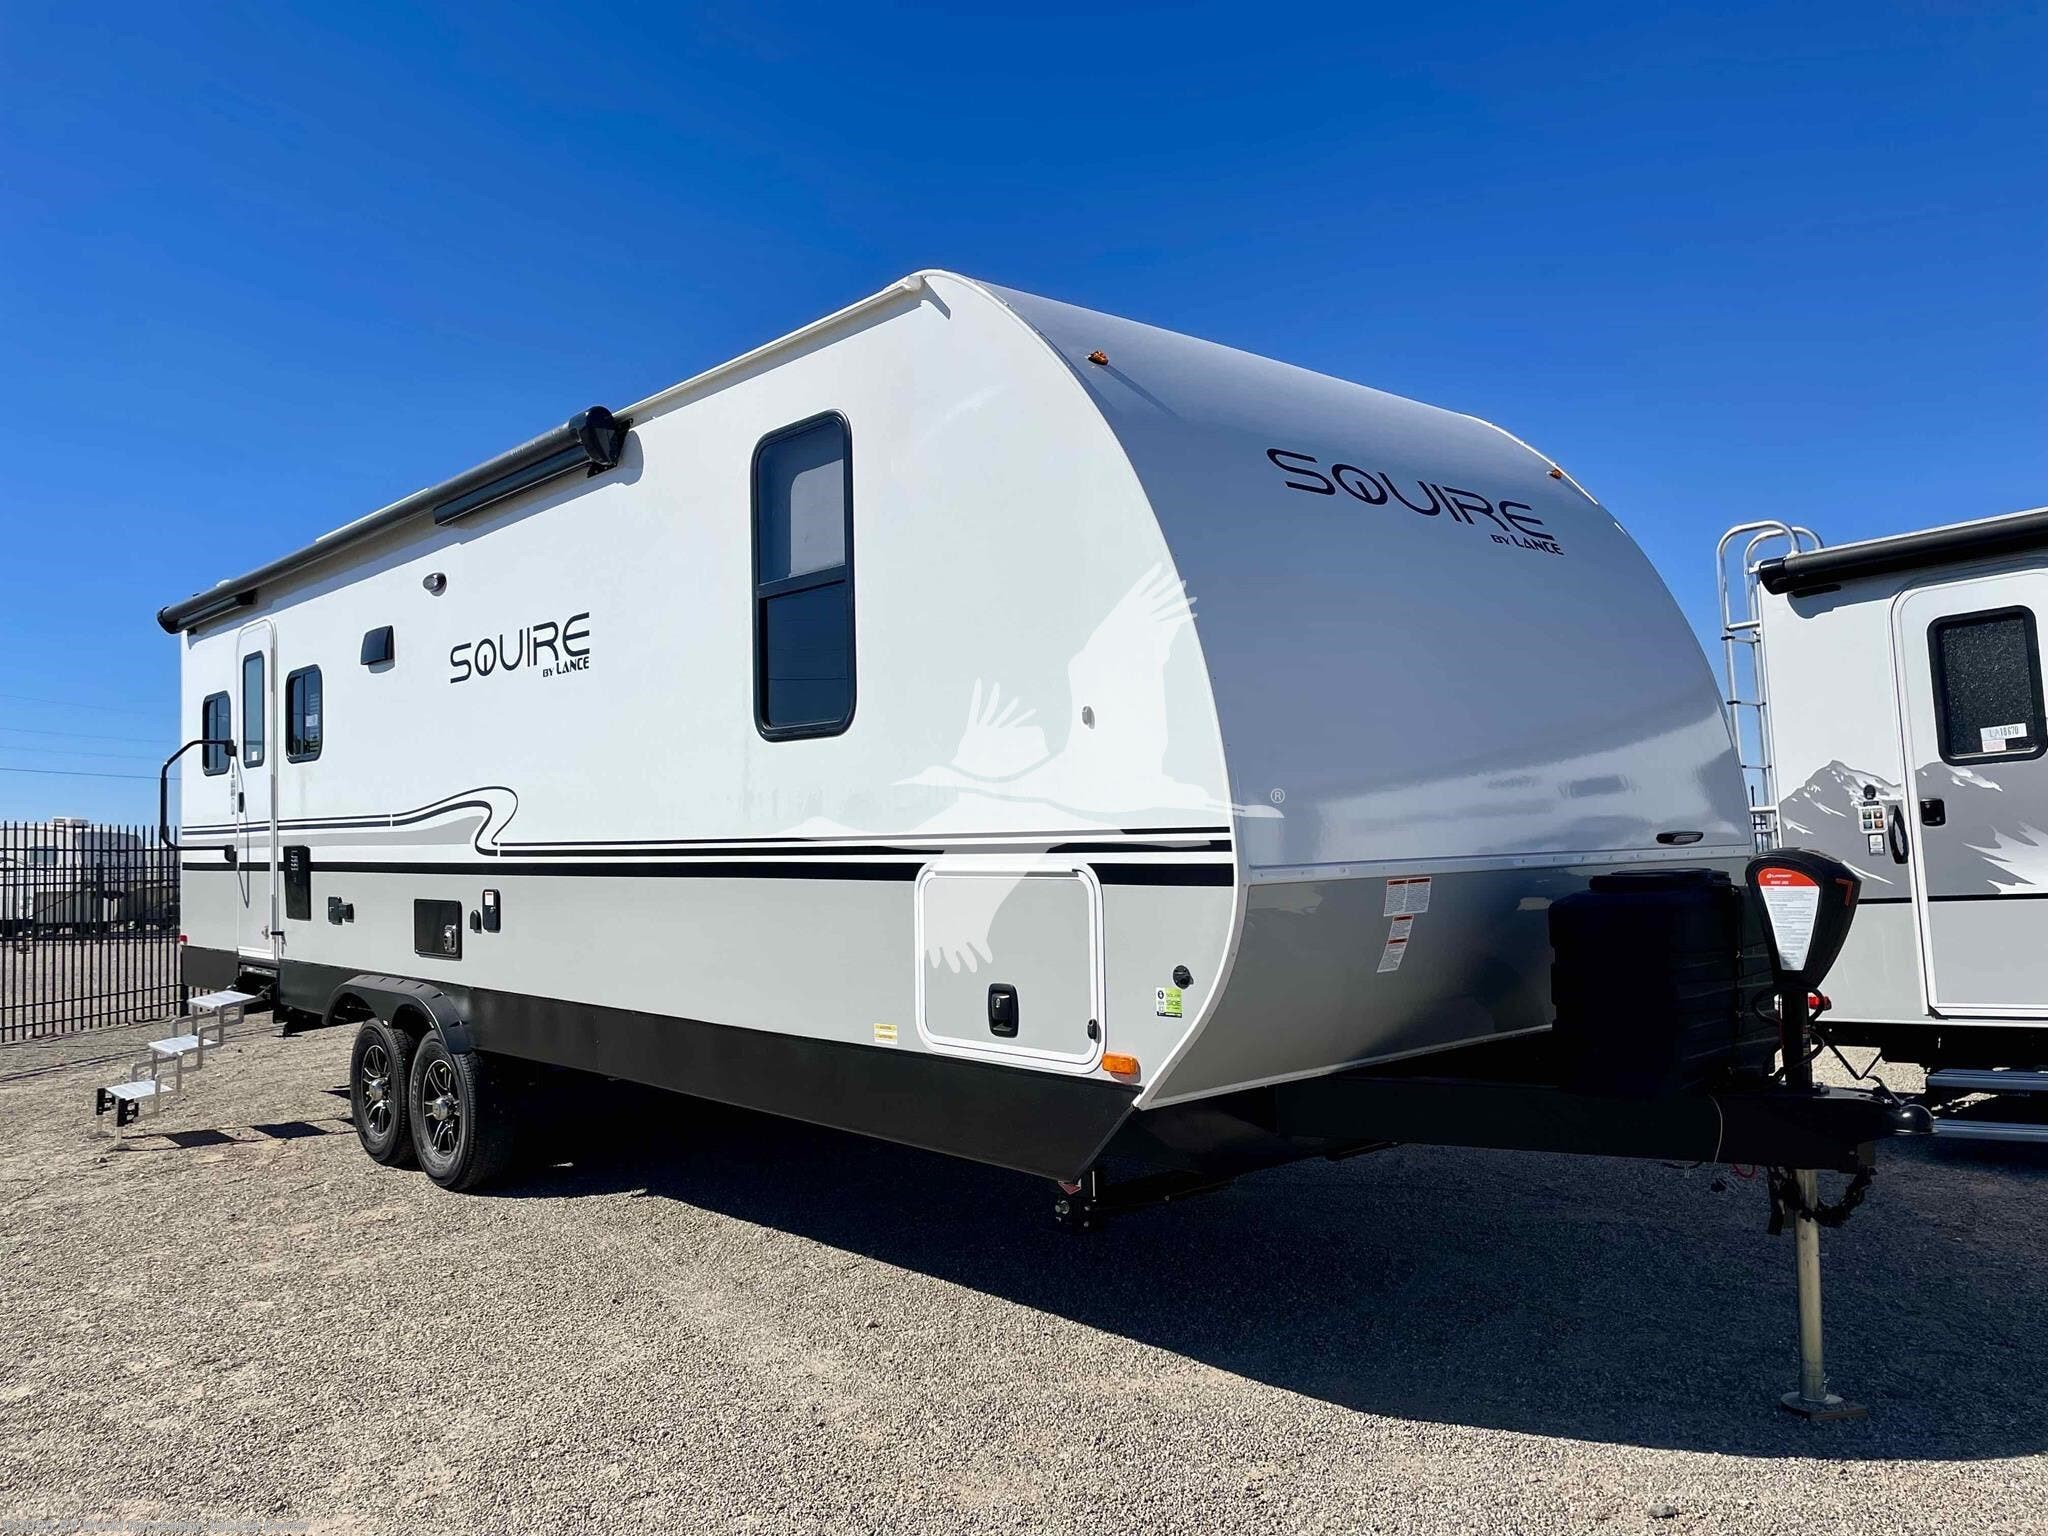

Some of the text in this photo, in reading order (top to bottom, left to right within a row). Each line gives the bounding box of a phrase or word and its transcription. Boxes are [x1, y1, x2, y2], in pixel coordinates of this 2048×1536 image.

[1266, 448, 1556, 542] SQUIRE
[1490, 534, 1565, 556] BY LANCE
[450, 611, 590, 684] SQUIRE
[543, 656, 590, 677] BY LANCE
